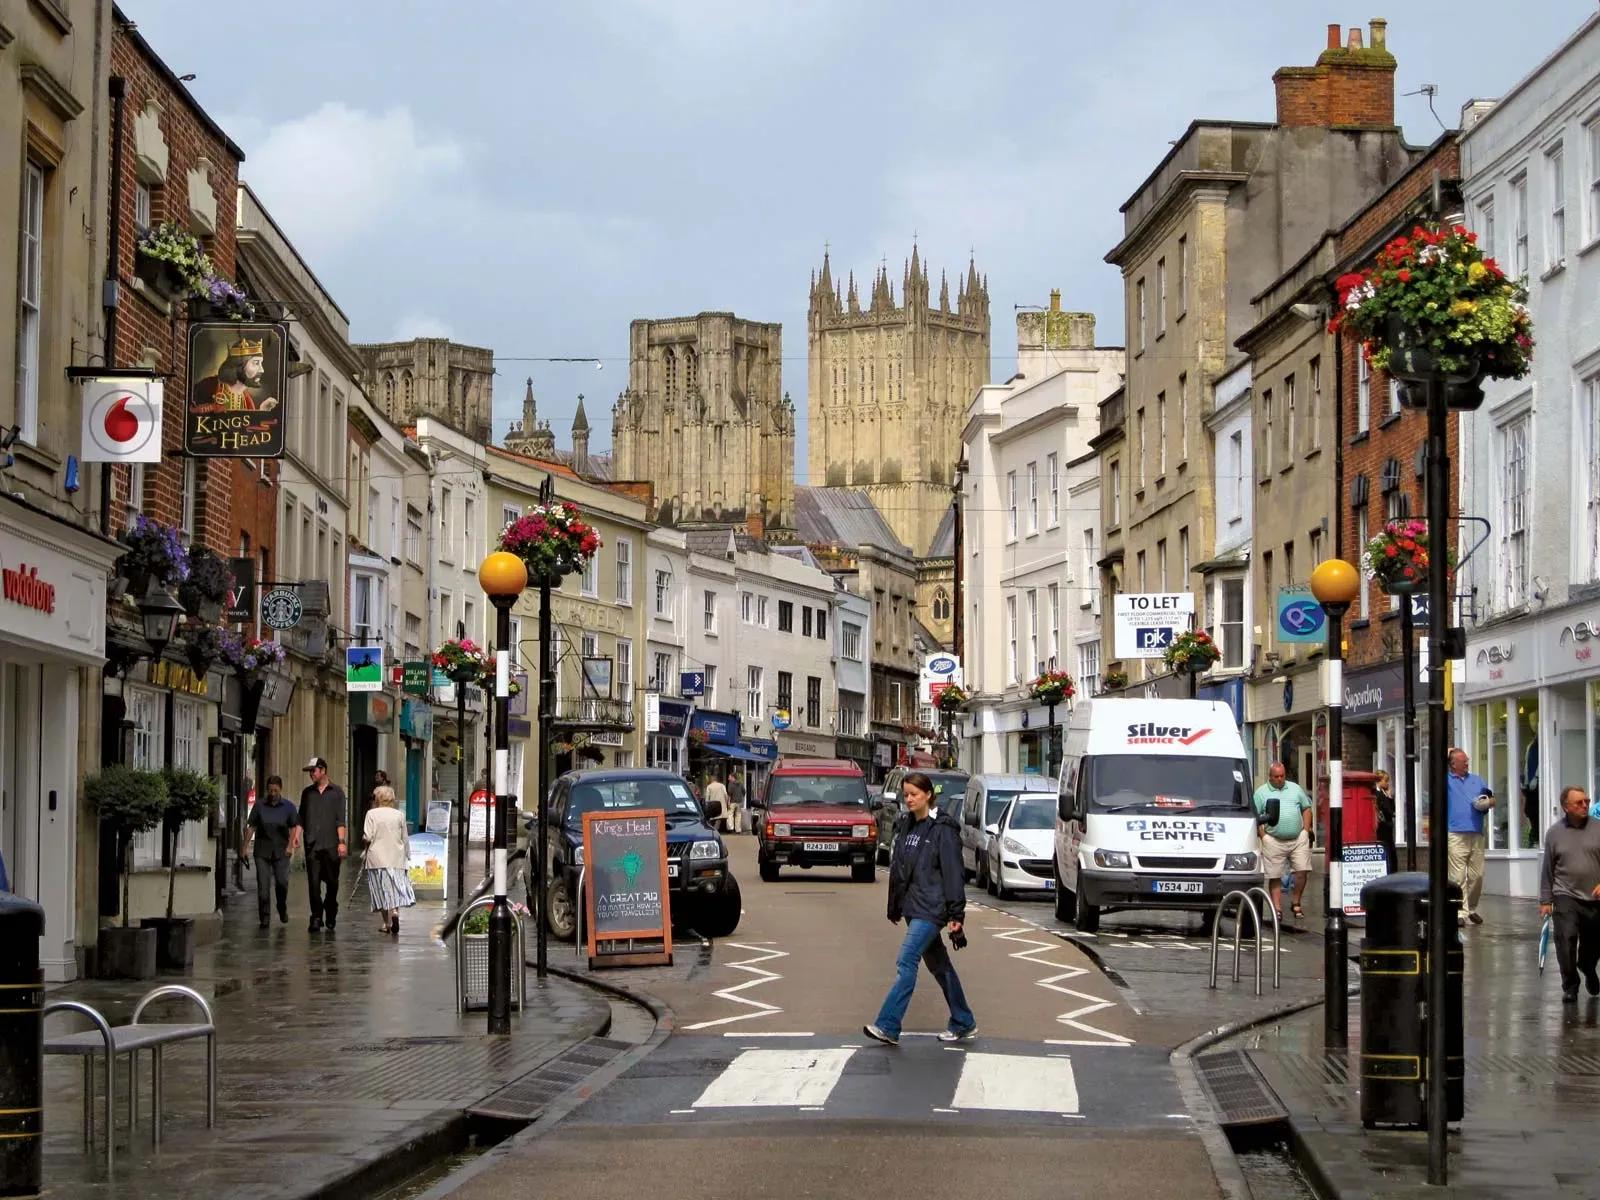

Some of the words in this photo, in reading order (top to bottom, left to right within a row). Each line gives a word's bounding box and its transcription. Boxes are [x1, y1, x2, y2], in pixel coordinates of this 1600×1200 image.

[196, 415, 250, 433] KINGS
[220, 431, 271, 449] HEAD
[3, 563, 56, 615] vodafone
[263, 590, 300, 609] STARBUCKS
[1128, 597, 1149, 610] TO
[1153, 596, 1180, 609] LET
[266, 617, 297, 629] COFFEE
[1144, 628, 1167, 648] pjk
[1476, 641, 1514, 666] new
[1345, 684, 1383, 712] Superdrug
[1127, 722, 1192, 738] Silver
[1127, 737, 1174, 745] SERVICE
[626, 820, 651, 833] Head
[1152, 821, 1200, 830] M.O.T
[1140, 831, 1215, 842] CENTRE
[1158, 882, 1182, 893] Y534
[599, 894, 608, 904] A
[609, 893, 641, 903] GREAT
